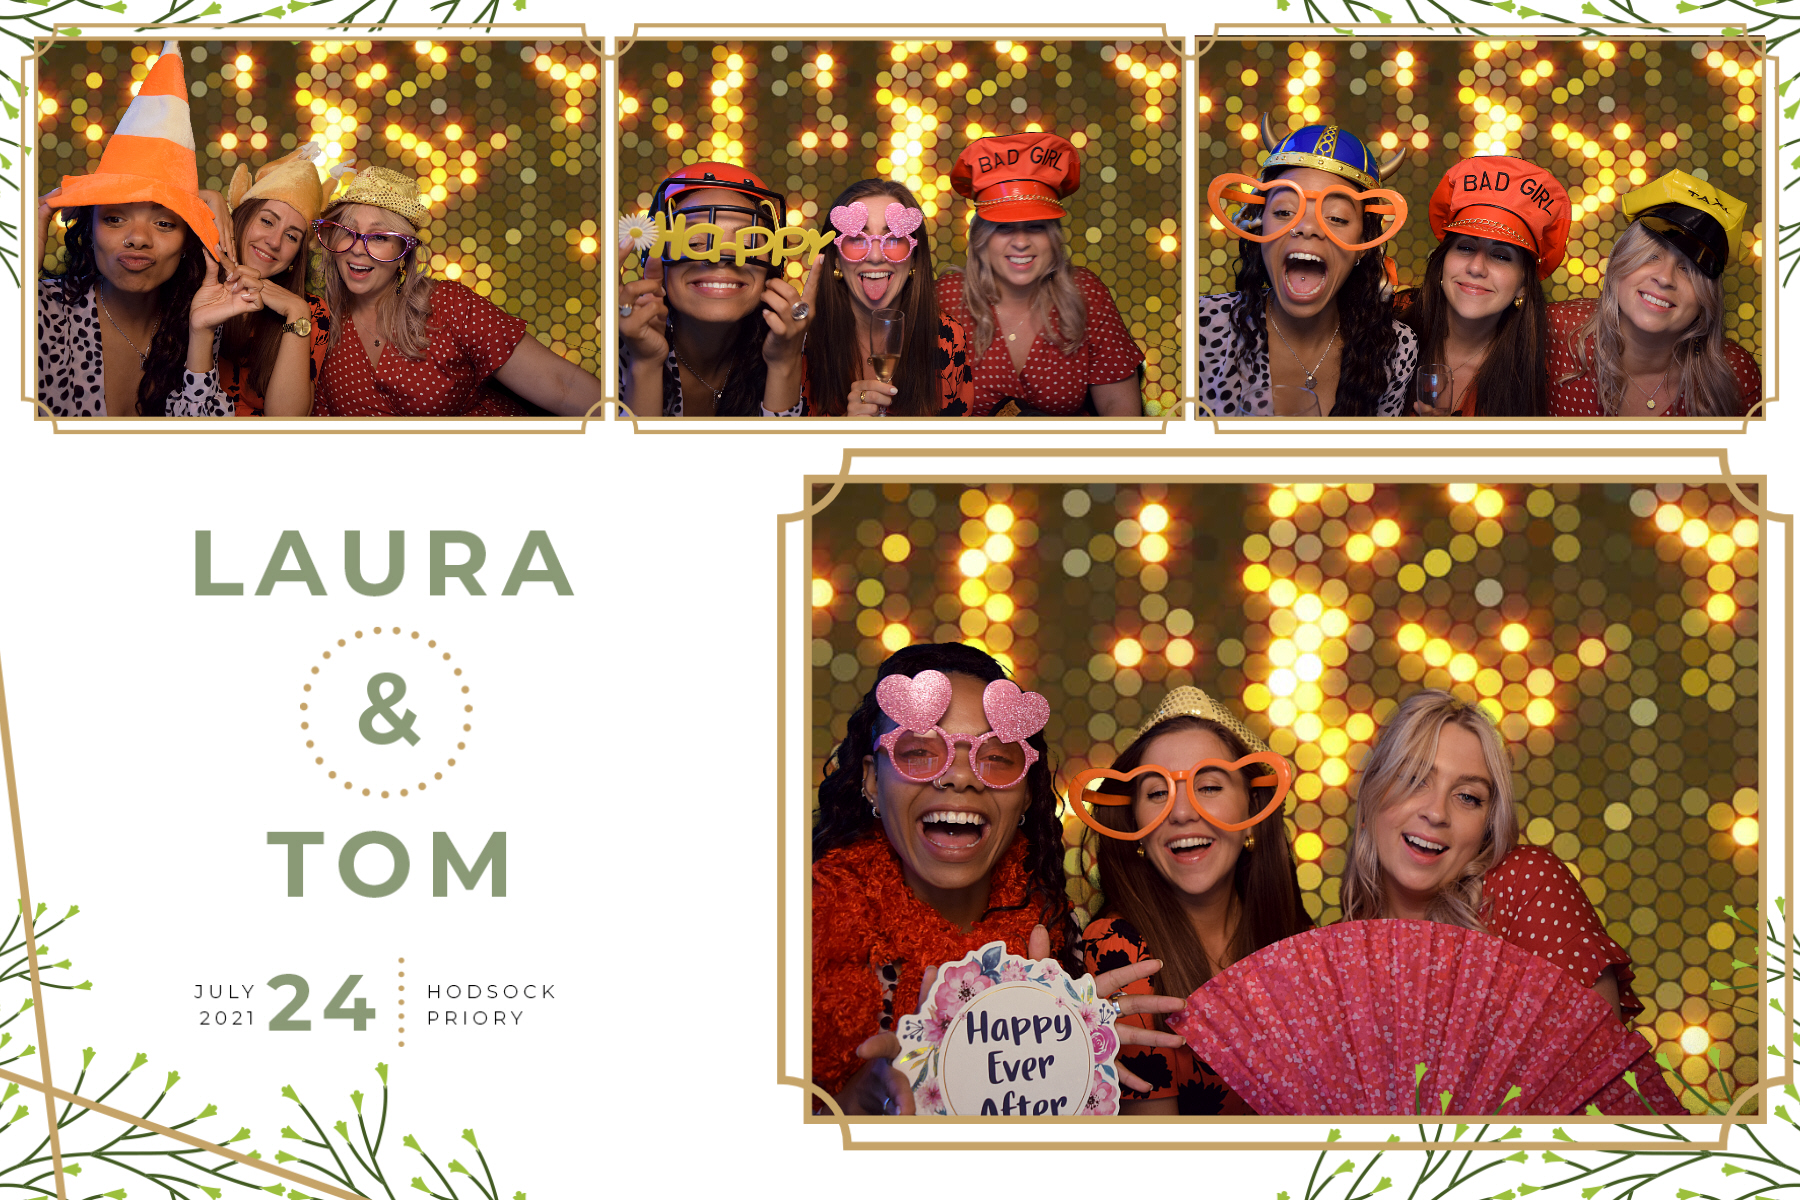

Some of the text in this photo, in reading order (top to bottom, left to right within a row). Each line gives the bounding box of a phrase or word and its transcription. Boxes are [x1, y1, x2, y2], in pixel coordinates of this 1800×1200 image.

[978, 146, 1063, 173] BAD GIRL
[1463, 171, 1555, 216] BAD GIRL
[649, 211, 837, 267] Happy
[967, 1010, 1072, 1046] Happy
[988, 1050, 1055, 1084] Ever
